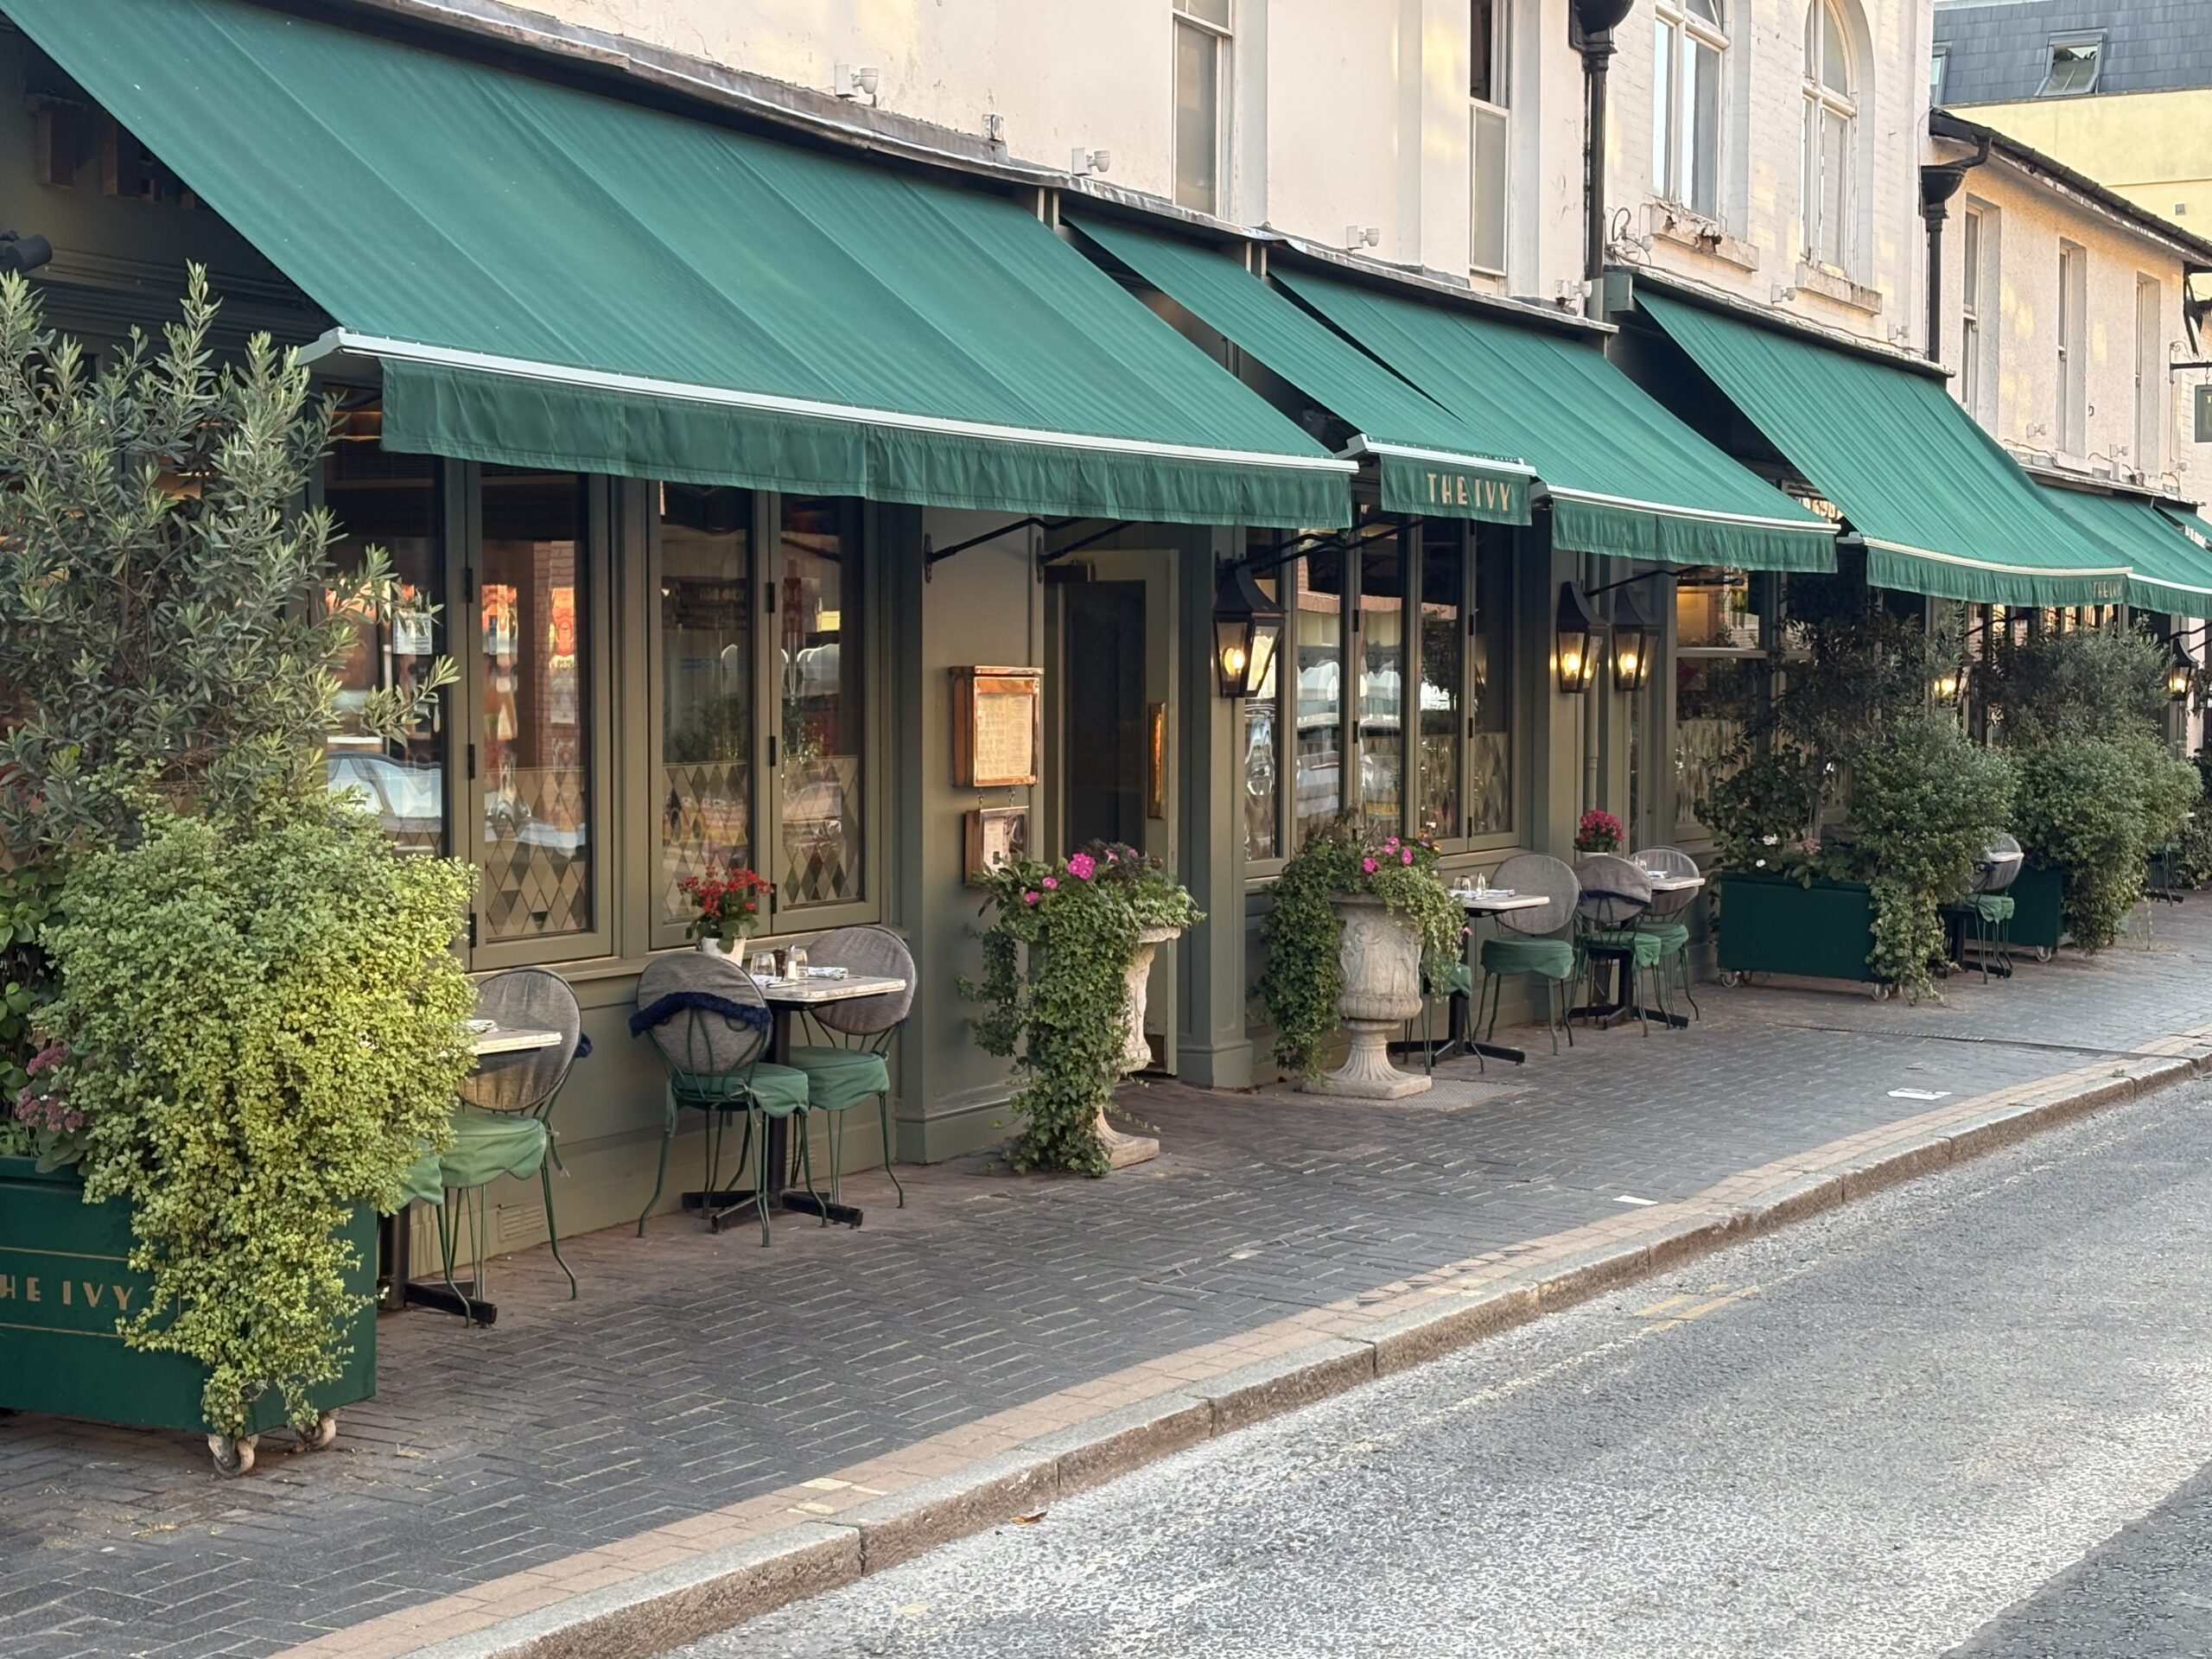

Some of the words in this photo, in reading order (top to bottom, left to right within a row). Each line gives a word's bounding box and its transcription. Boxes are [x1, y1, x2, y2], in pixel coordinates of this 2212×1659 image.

[1427, 473, 1468, 505] THE
[1474, 478, 1510, 512] IVY
[62, 1280, 133, 1311] IVY
